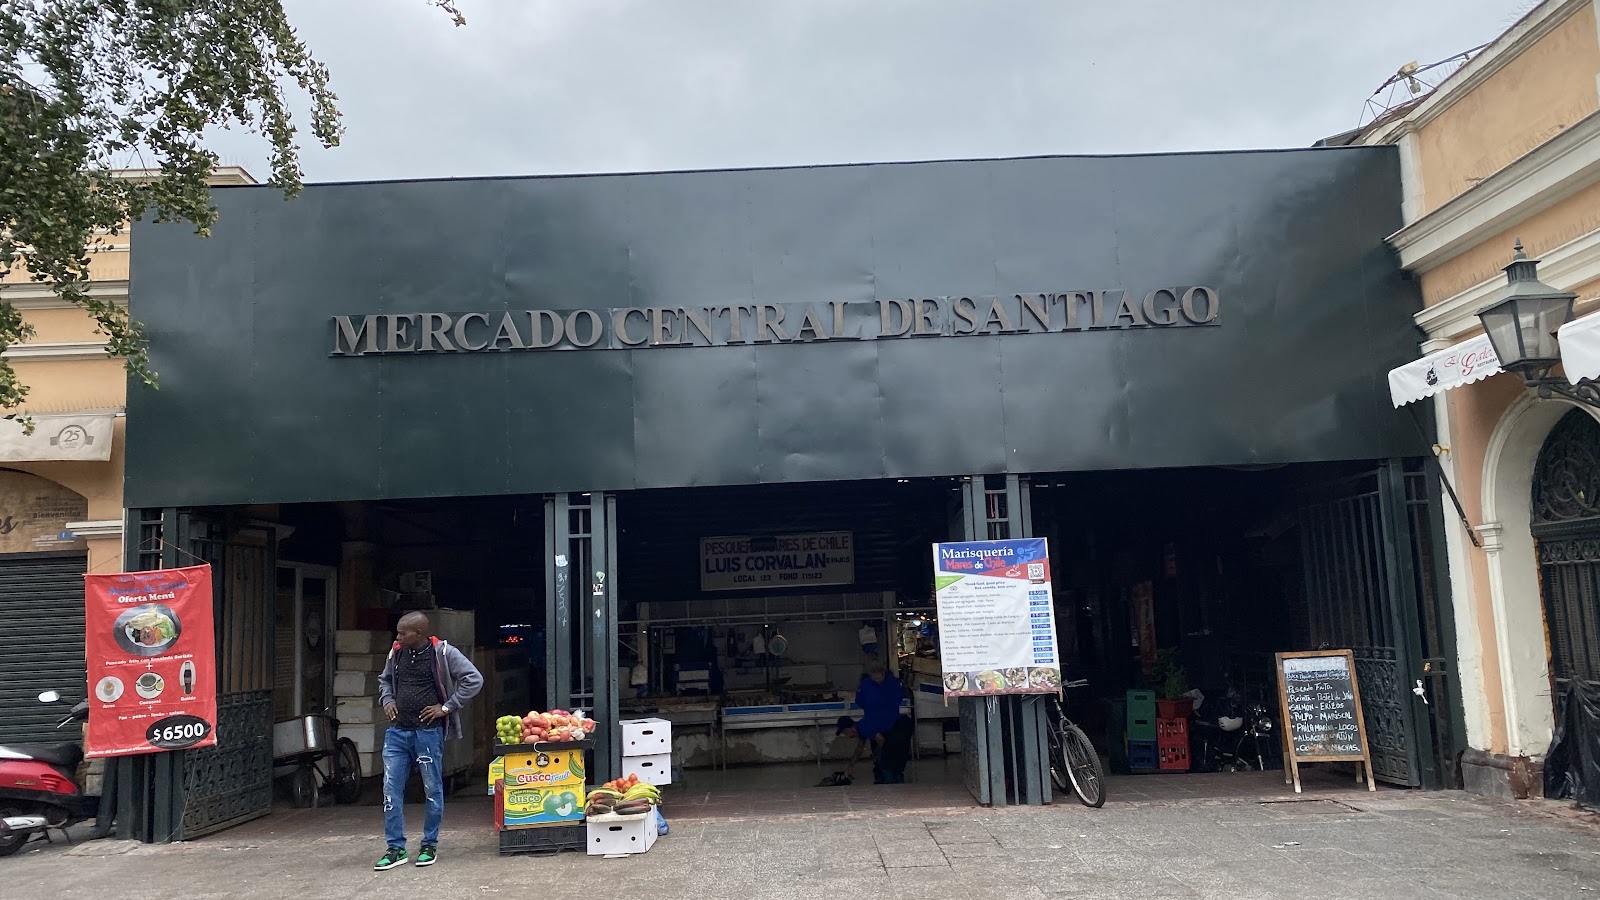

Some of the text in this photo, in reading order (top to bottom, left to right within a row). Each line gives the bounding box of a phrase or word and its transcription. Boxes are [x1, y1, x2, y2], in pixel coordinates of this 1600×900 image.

[331, 285, 1220, 355] MERCADO CENTRAL DE SANTIAGO
[64, 430, 81, 442] 25
[802, 537, 816, 551] DE
[819, 536, 849, 550] CHILE
[942, 547, 1014, 561] Marisquería
[705, 556, 741, 574] LUIS
[744, 552, 827, 572] CORVALAN
[945, 557, 1006, 570] Mares de Chile
[733, 574, 757, 583] LOCAL
[760, 574, 771, 582] 123
[118, 591, 175, 604] Oferta Menú
[1288, 683, 1313, 693] Pescado
[154, 722, 204, 742] $6500
[1338, 723, 1358, 732] LOCOS
